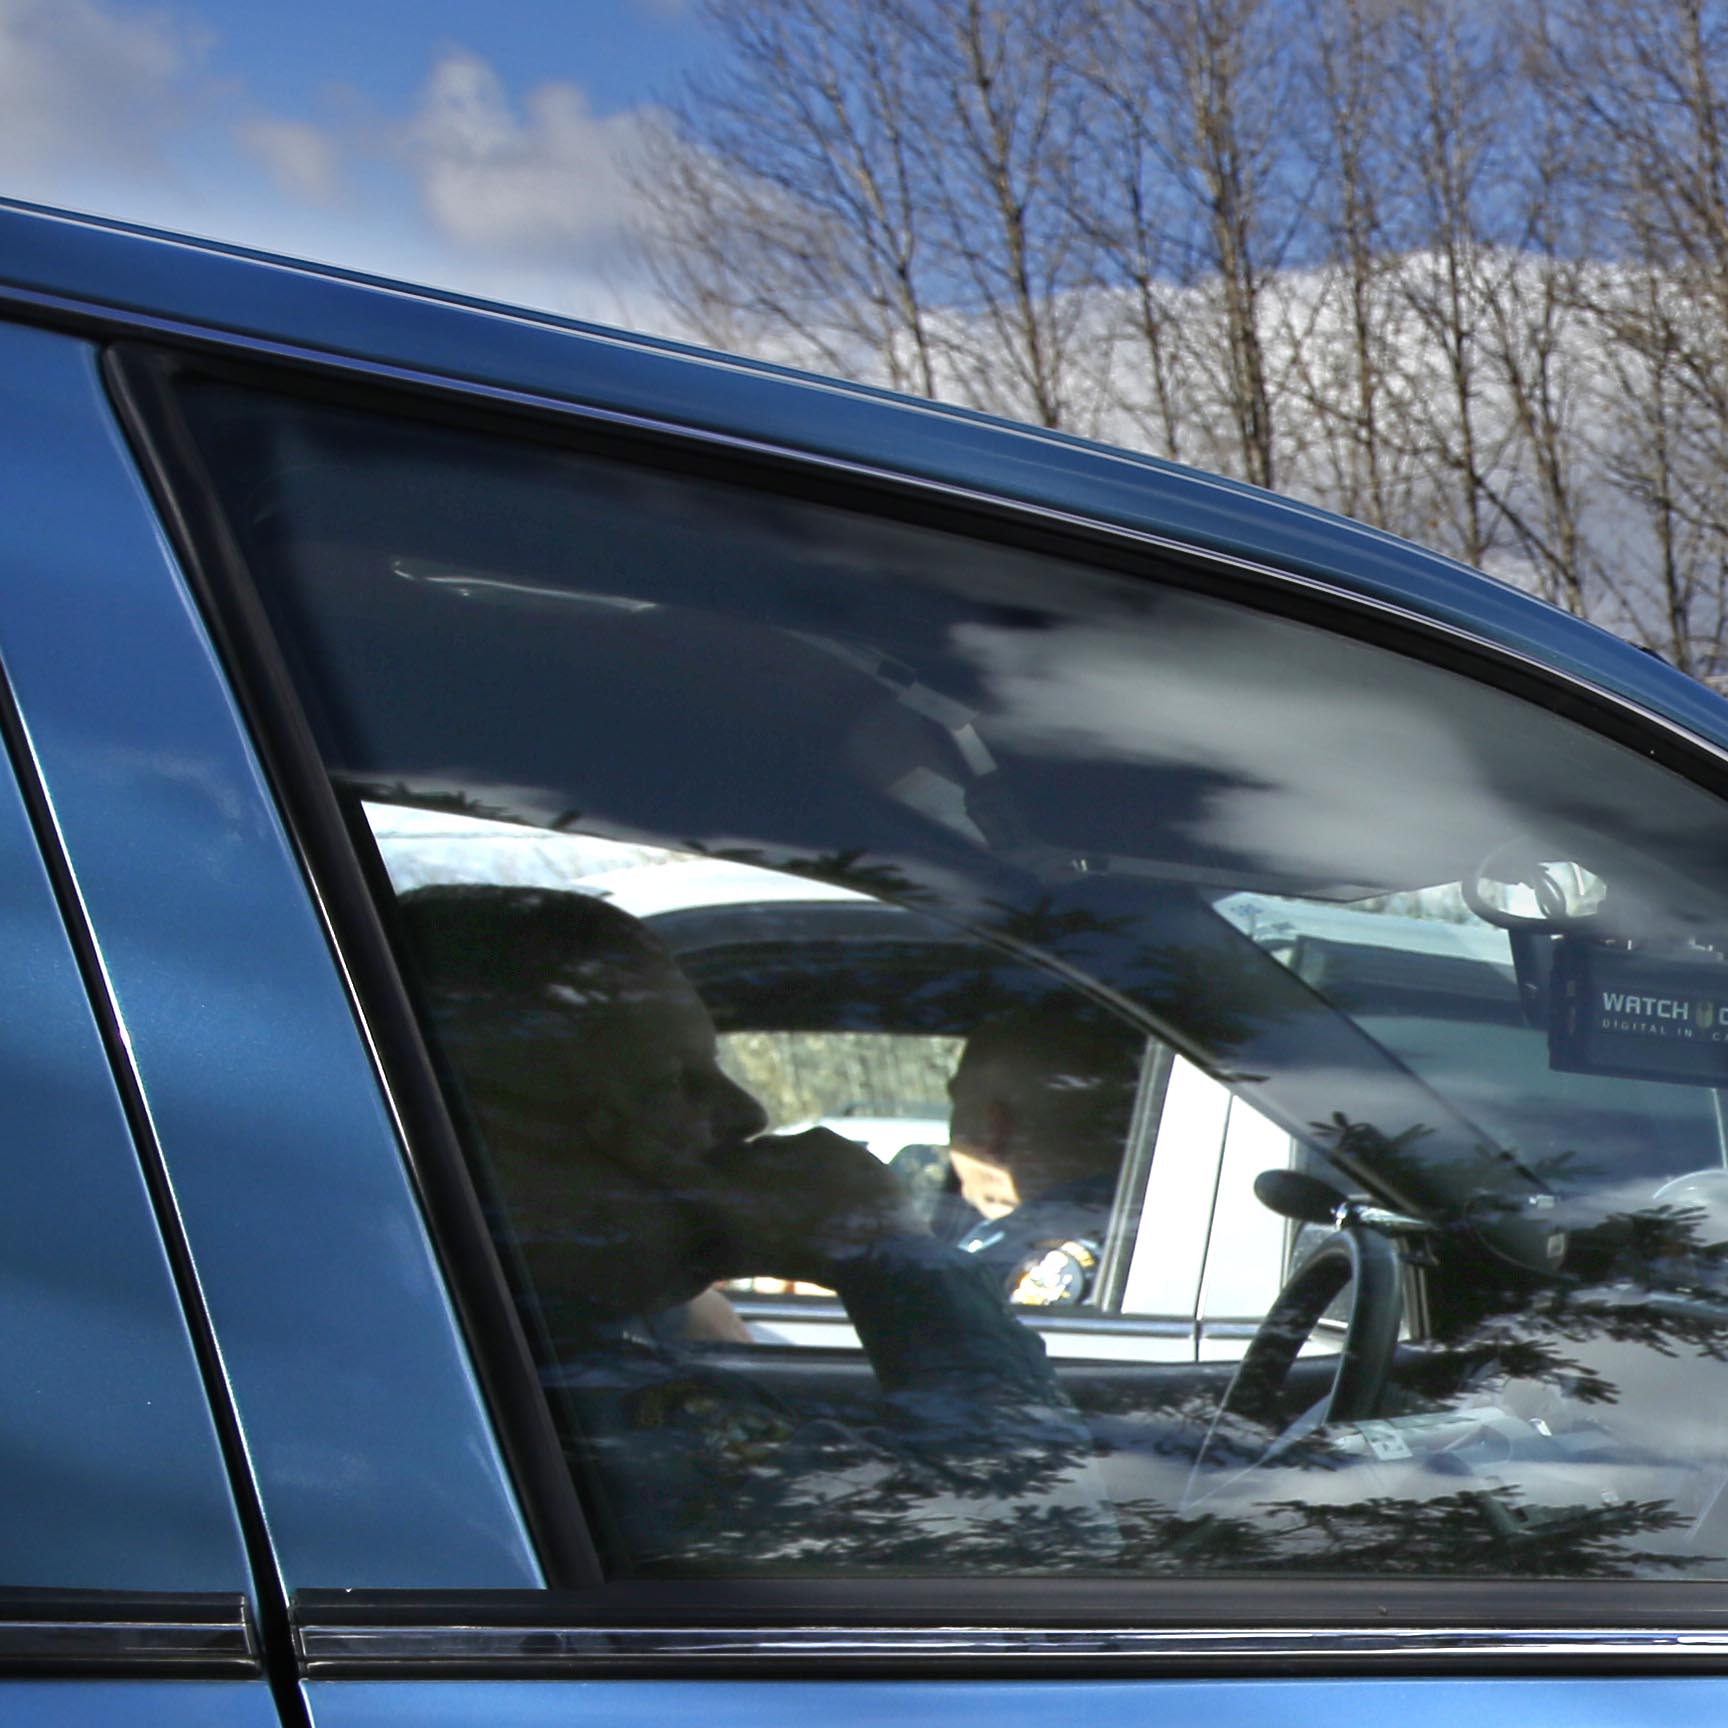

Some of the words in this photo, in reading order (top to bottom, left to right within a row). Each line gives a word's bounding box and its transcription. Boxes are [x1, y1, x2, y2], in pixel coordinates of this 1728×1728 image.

[1602, 991, 1689, 1020] WATCH
[1602, 1018, 1668, 1036] DIGITAL
[1677, 1027, 1693, 1038] IN
